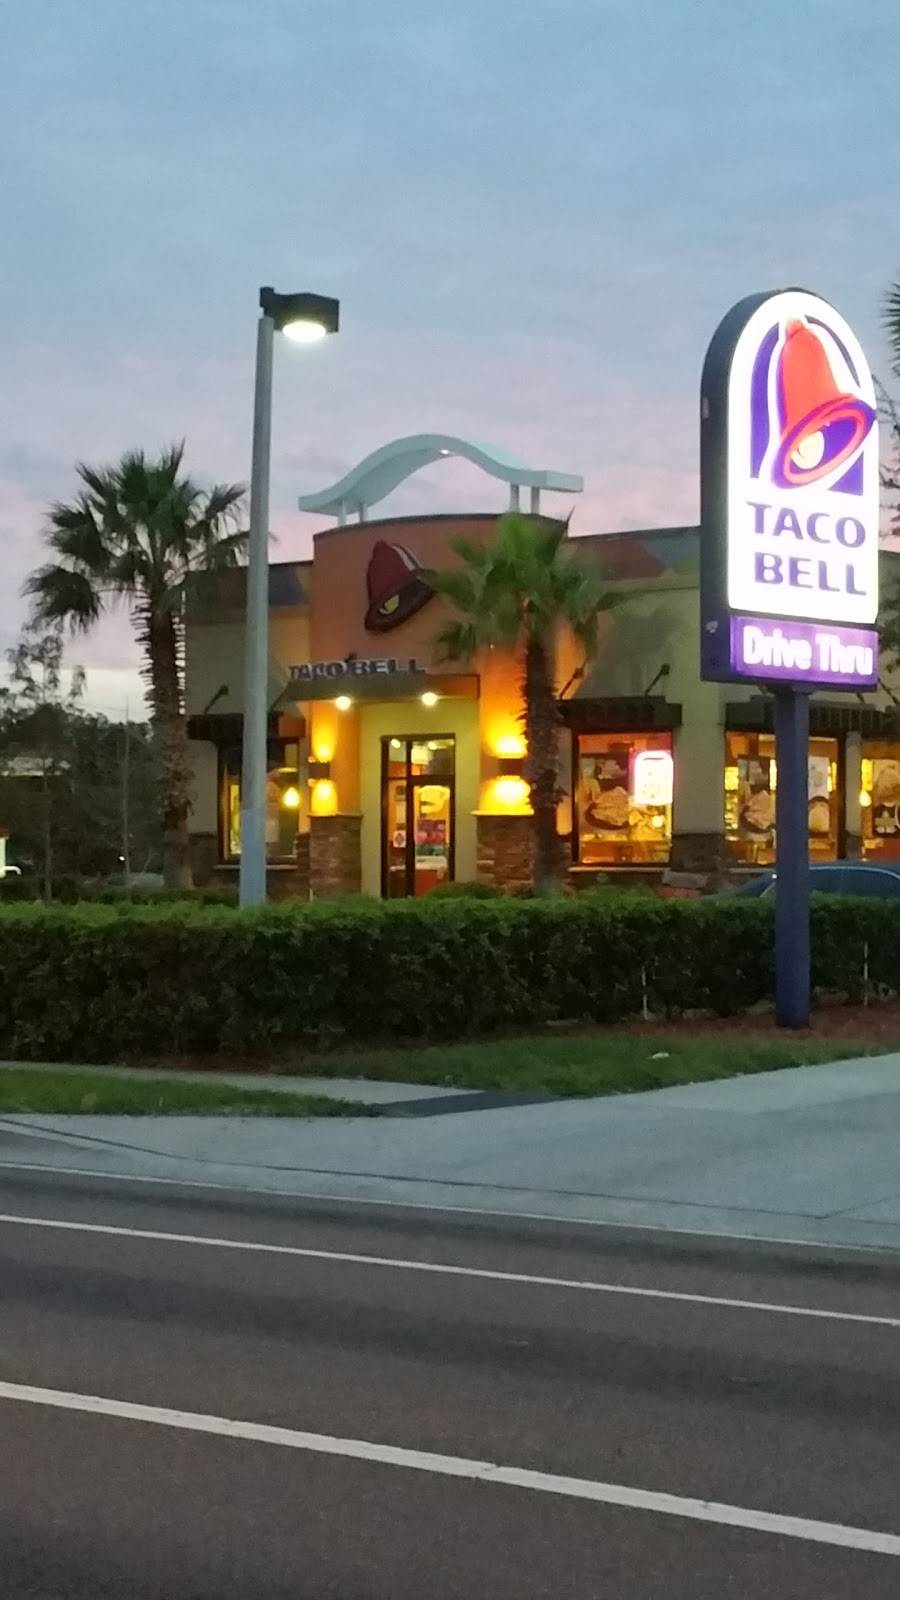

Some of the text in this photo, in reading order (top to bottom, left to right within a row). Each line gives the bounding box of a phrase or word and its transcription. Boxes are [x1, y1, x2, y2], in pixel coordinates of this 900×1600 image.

[746, 501, 866, 548] TACO
[754, 551, 867, 596] BELL
[288, 658, 426, 682] TACO BELL
[743, 625, 873, 676] Drive Thru
